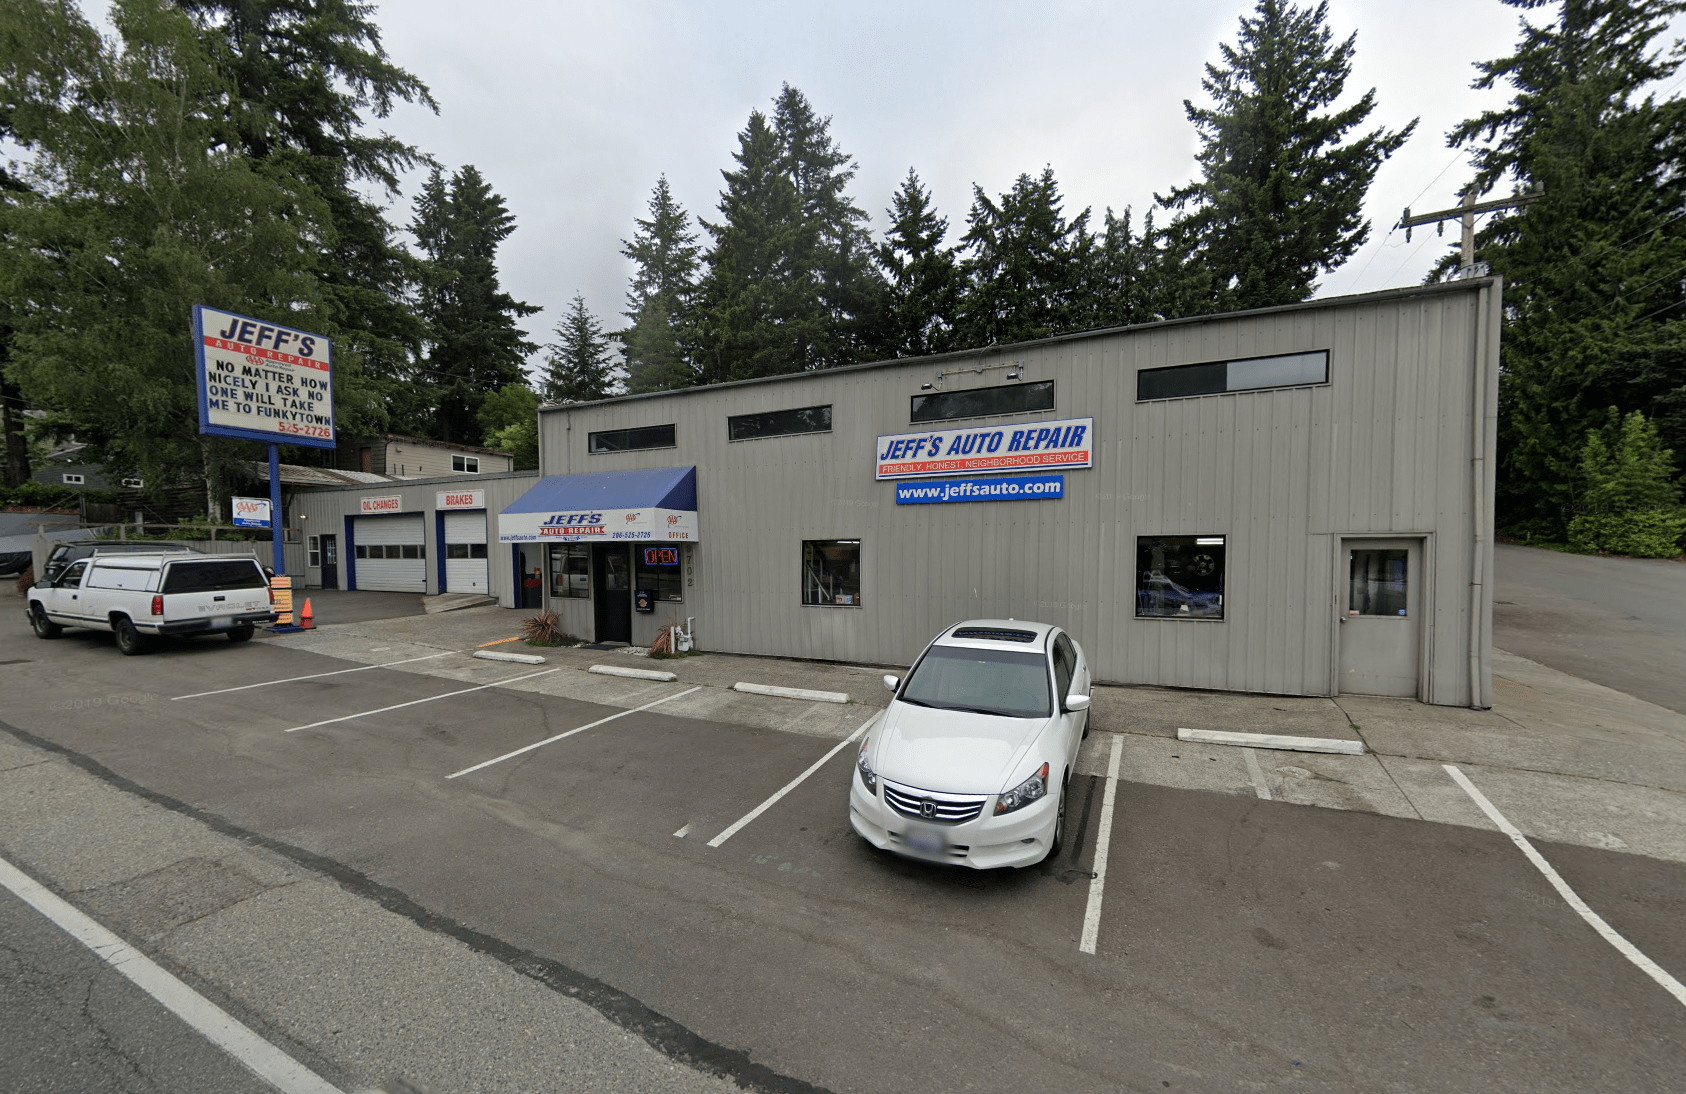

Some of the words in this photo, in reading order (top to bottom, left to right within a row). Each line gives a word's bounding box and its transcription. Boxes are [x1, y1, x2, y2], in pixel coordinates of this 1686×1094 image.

[220, 318, 315, 357] JEFF'S
[215, 340, 257, 355] AUTO
[267, 351, 321, 369] REPAIR
[216, 360, 235, 373] NO
[242, 366, 294, 385] MATTER
[301, 377, 328, 391] HOW
[208, 372, 257, 389] NICELY
[265, 382, 269, 392] I
[276, 385, 300, 398] ASK
[308, 390, 323, 401] NO
[209, 385, 238, 399] ONE
[243, 391, 275, 405] WILL
[281, 397, 314, 412] TAKE
[209, 398, 229, 411] ME
[234, 401, 252, 414] TO
[257, 405, 331, 426] FUNKYTOWN
[277, 421, 331, 438] 525-2726
[880, 435, 943, 460] JEFF'S
[946, 431, 1004, 455] AUTO
[1007, 425, 1087, 452] REPAIR
[965, 455, 1041, 468] NEIGHBORHOOD
[445, 494, 473, 506] BRAKES
[899, 481, 1061, 500] www.jeffsauto.com
[362, 499, 371, 510] OIL
[372, 499, 399, 511] CHANGES
[543, 527, 565, 535] AUTO
[568, 526, 601, 534] REPAIR
[612, 531, 651, 539] 206-525-2726
[645, 549, 677, 563] OPEN
